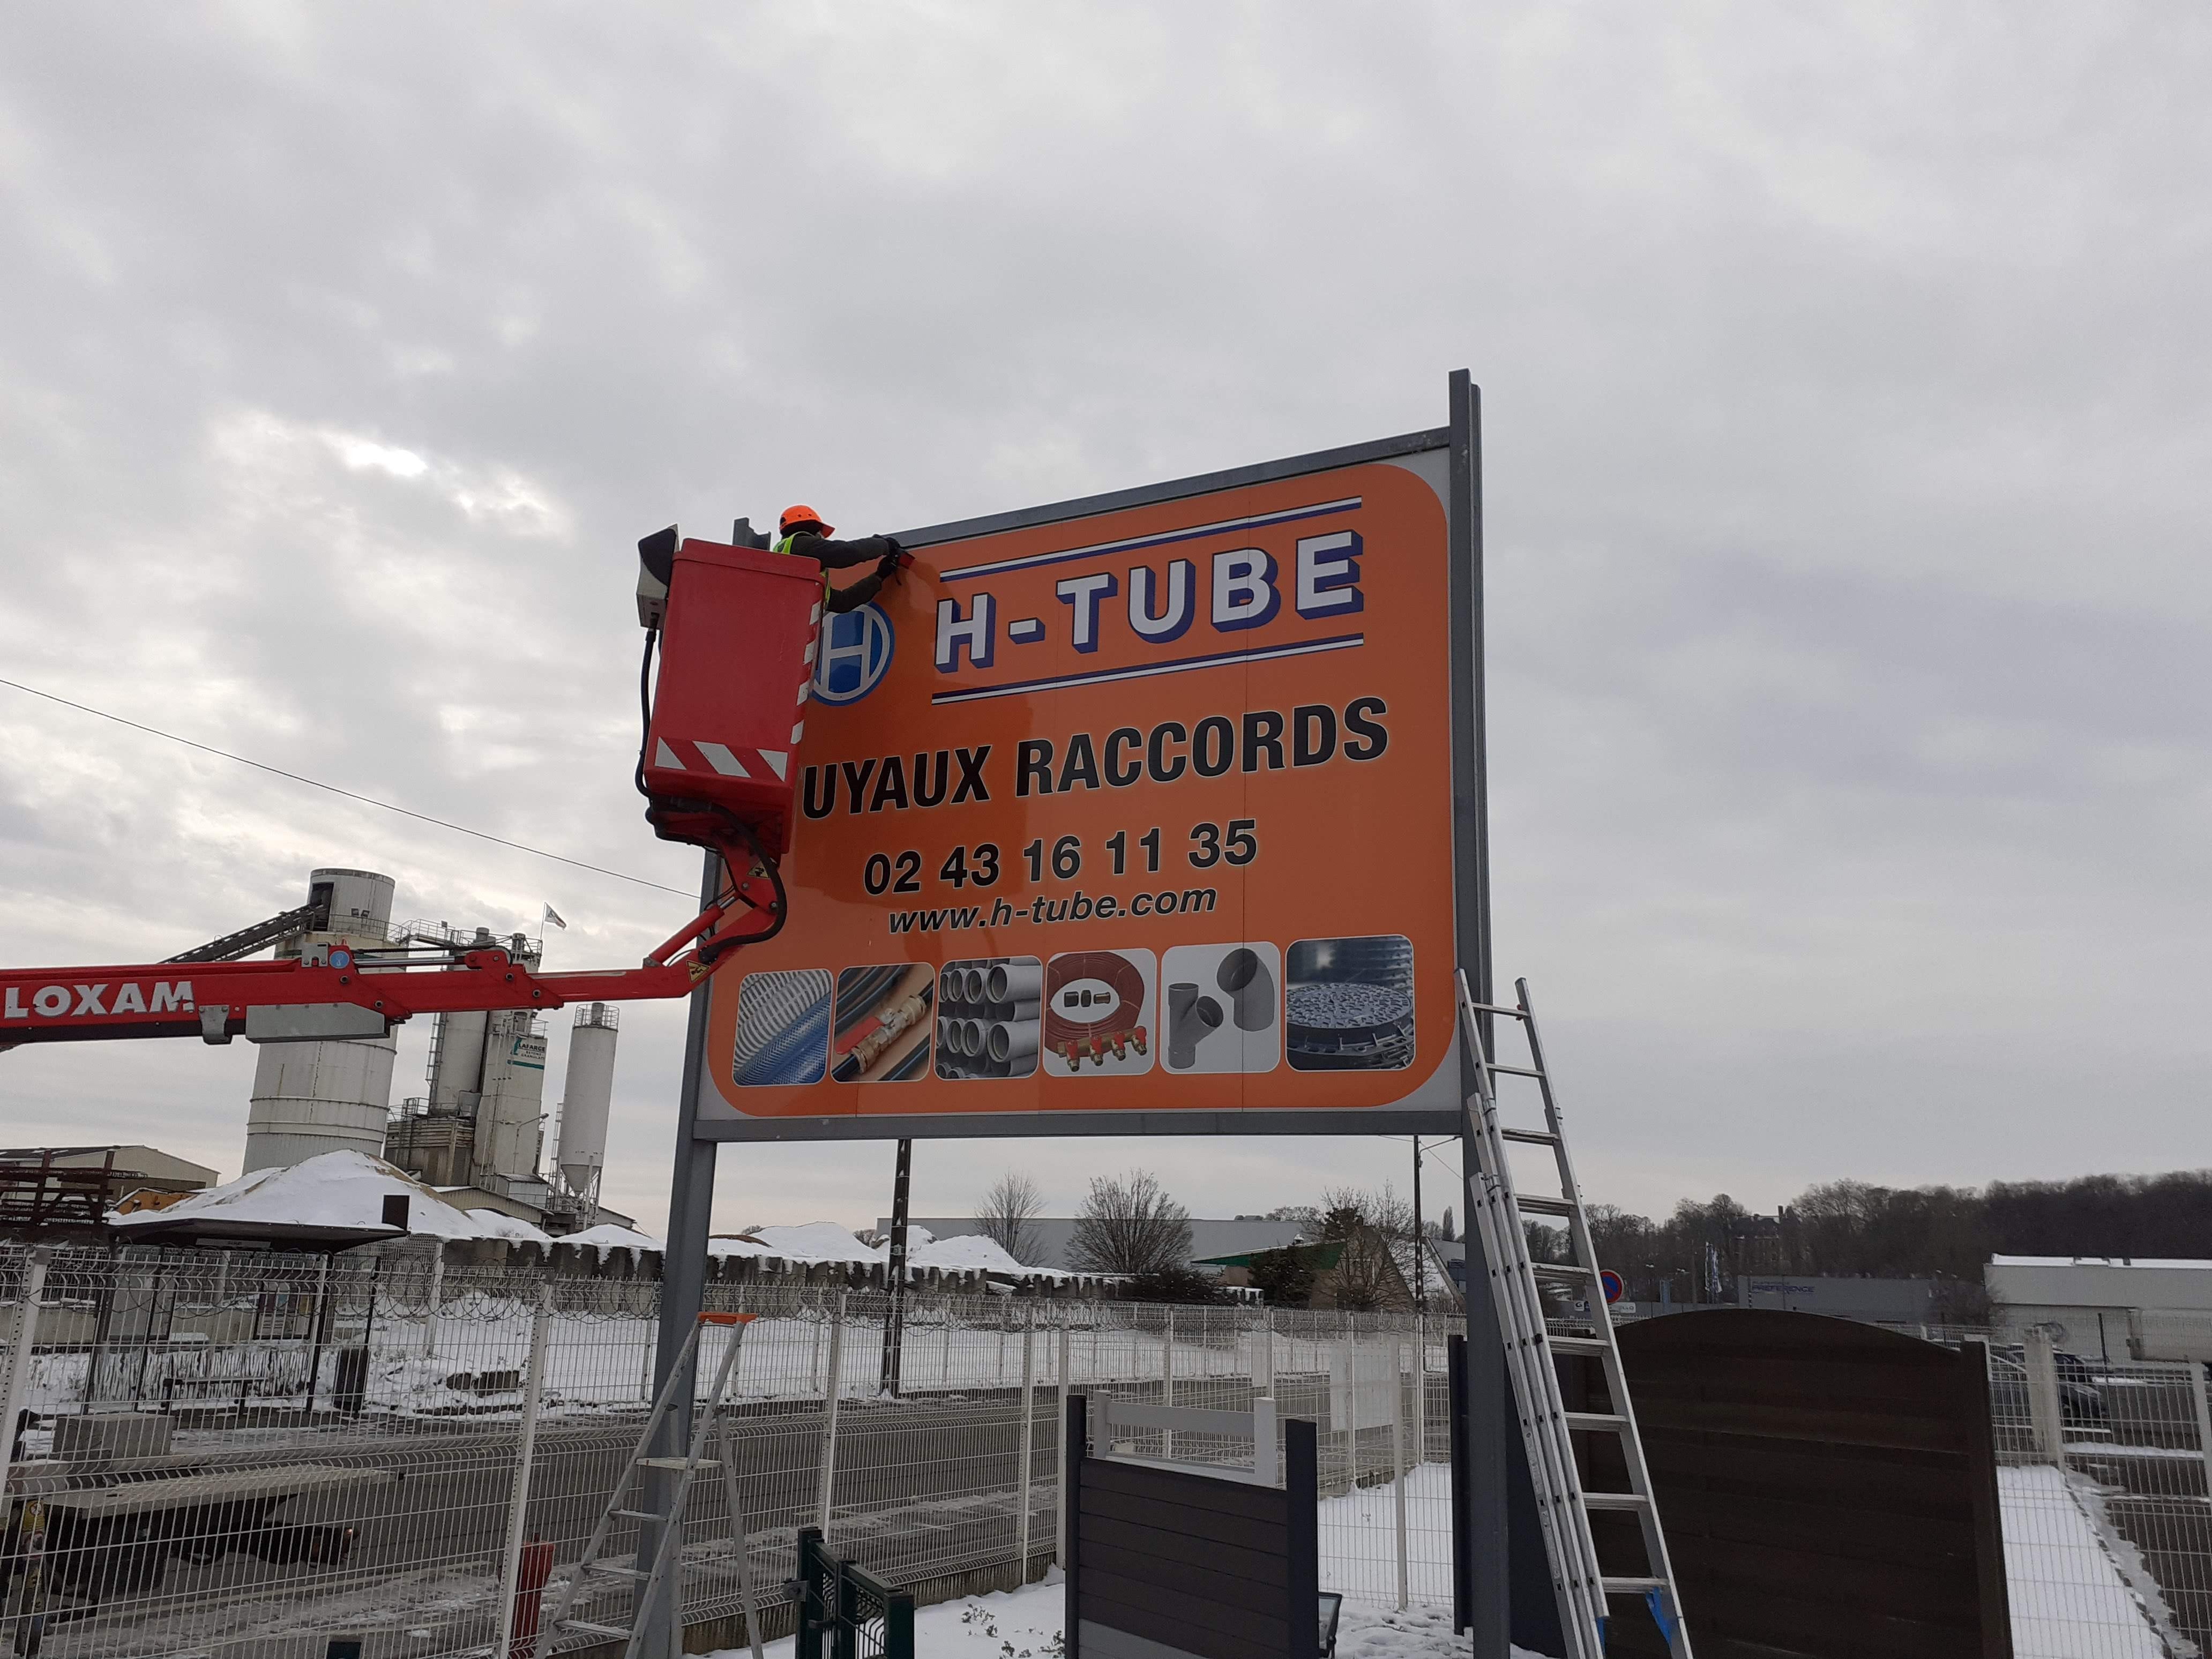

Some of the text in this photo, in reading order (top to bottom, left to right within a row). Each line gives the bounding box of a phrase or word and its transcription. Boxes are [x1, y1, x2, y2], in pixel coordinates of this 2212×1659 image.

[935, 529, 1364, 673] H-TUBE
[798, 696, 1389, 820] UYAUX RACCORDS
[863, 818, 1258, 896] 02 43 16 11 35
[889, 887, 1217, 934] www.h-tube.com
[4, 981, 195, 1018] LOXAM
[518, 1043, 545, 1051] LAFARGE
